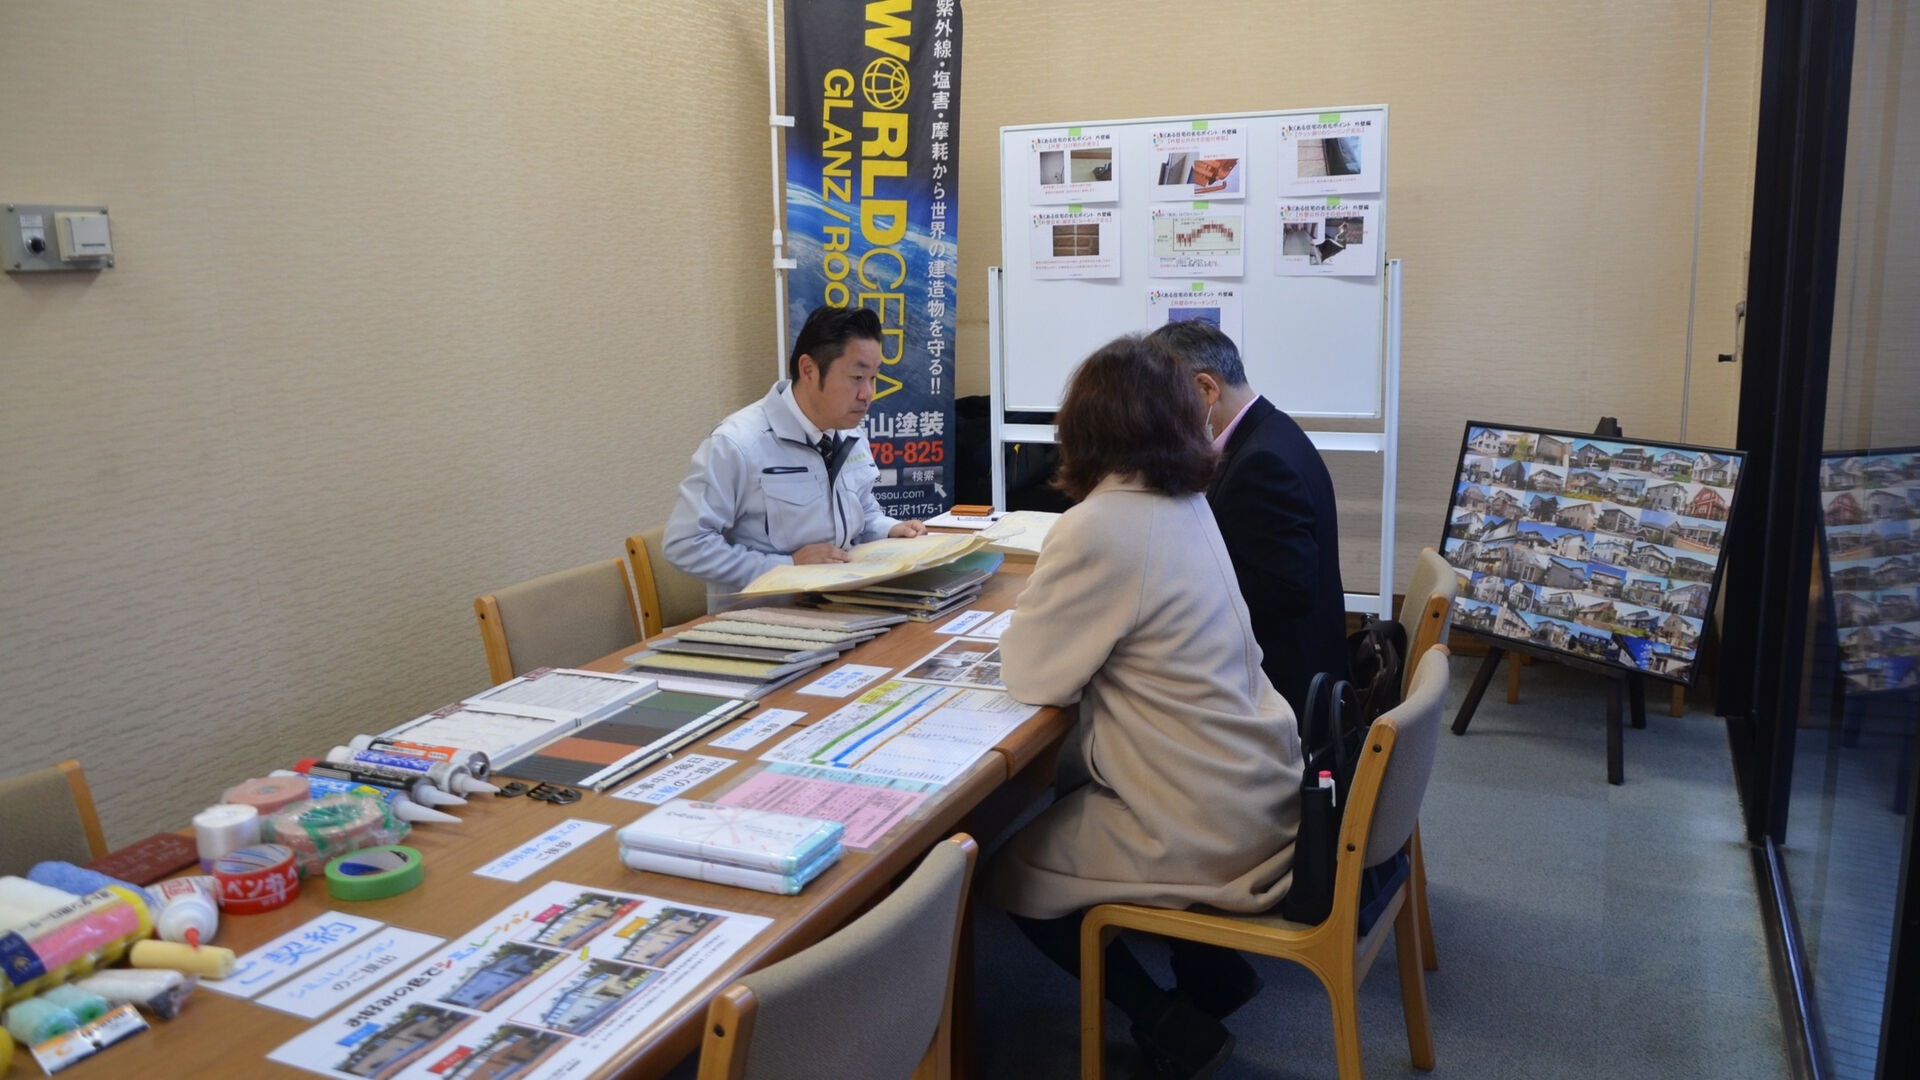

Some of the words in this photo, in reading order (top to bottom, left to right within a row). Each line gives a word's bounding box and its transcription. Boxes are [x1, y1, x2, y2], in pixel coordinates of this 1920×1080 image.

[912, 470, 935, 482] 検索
[227, 920, 358, 986] ご契約
[289, 938, 396, 999] シミュレーション
[344, 909, 530, 1029] お好みの色でシミュレーション
